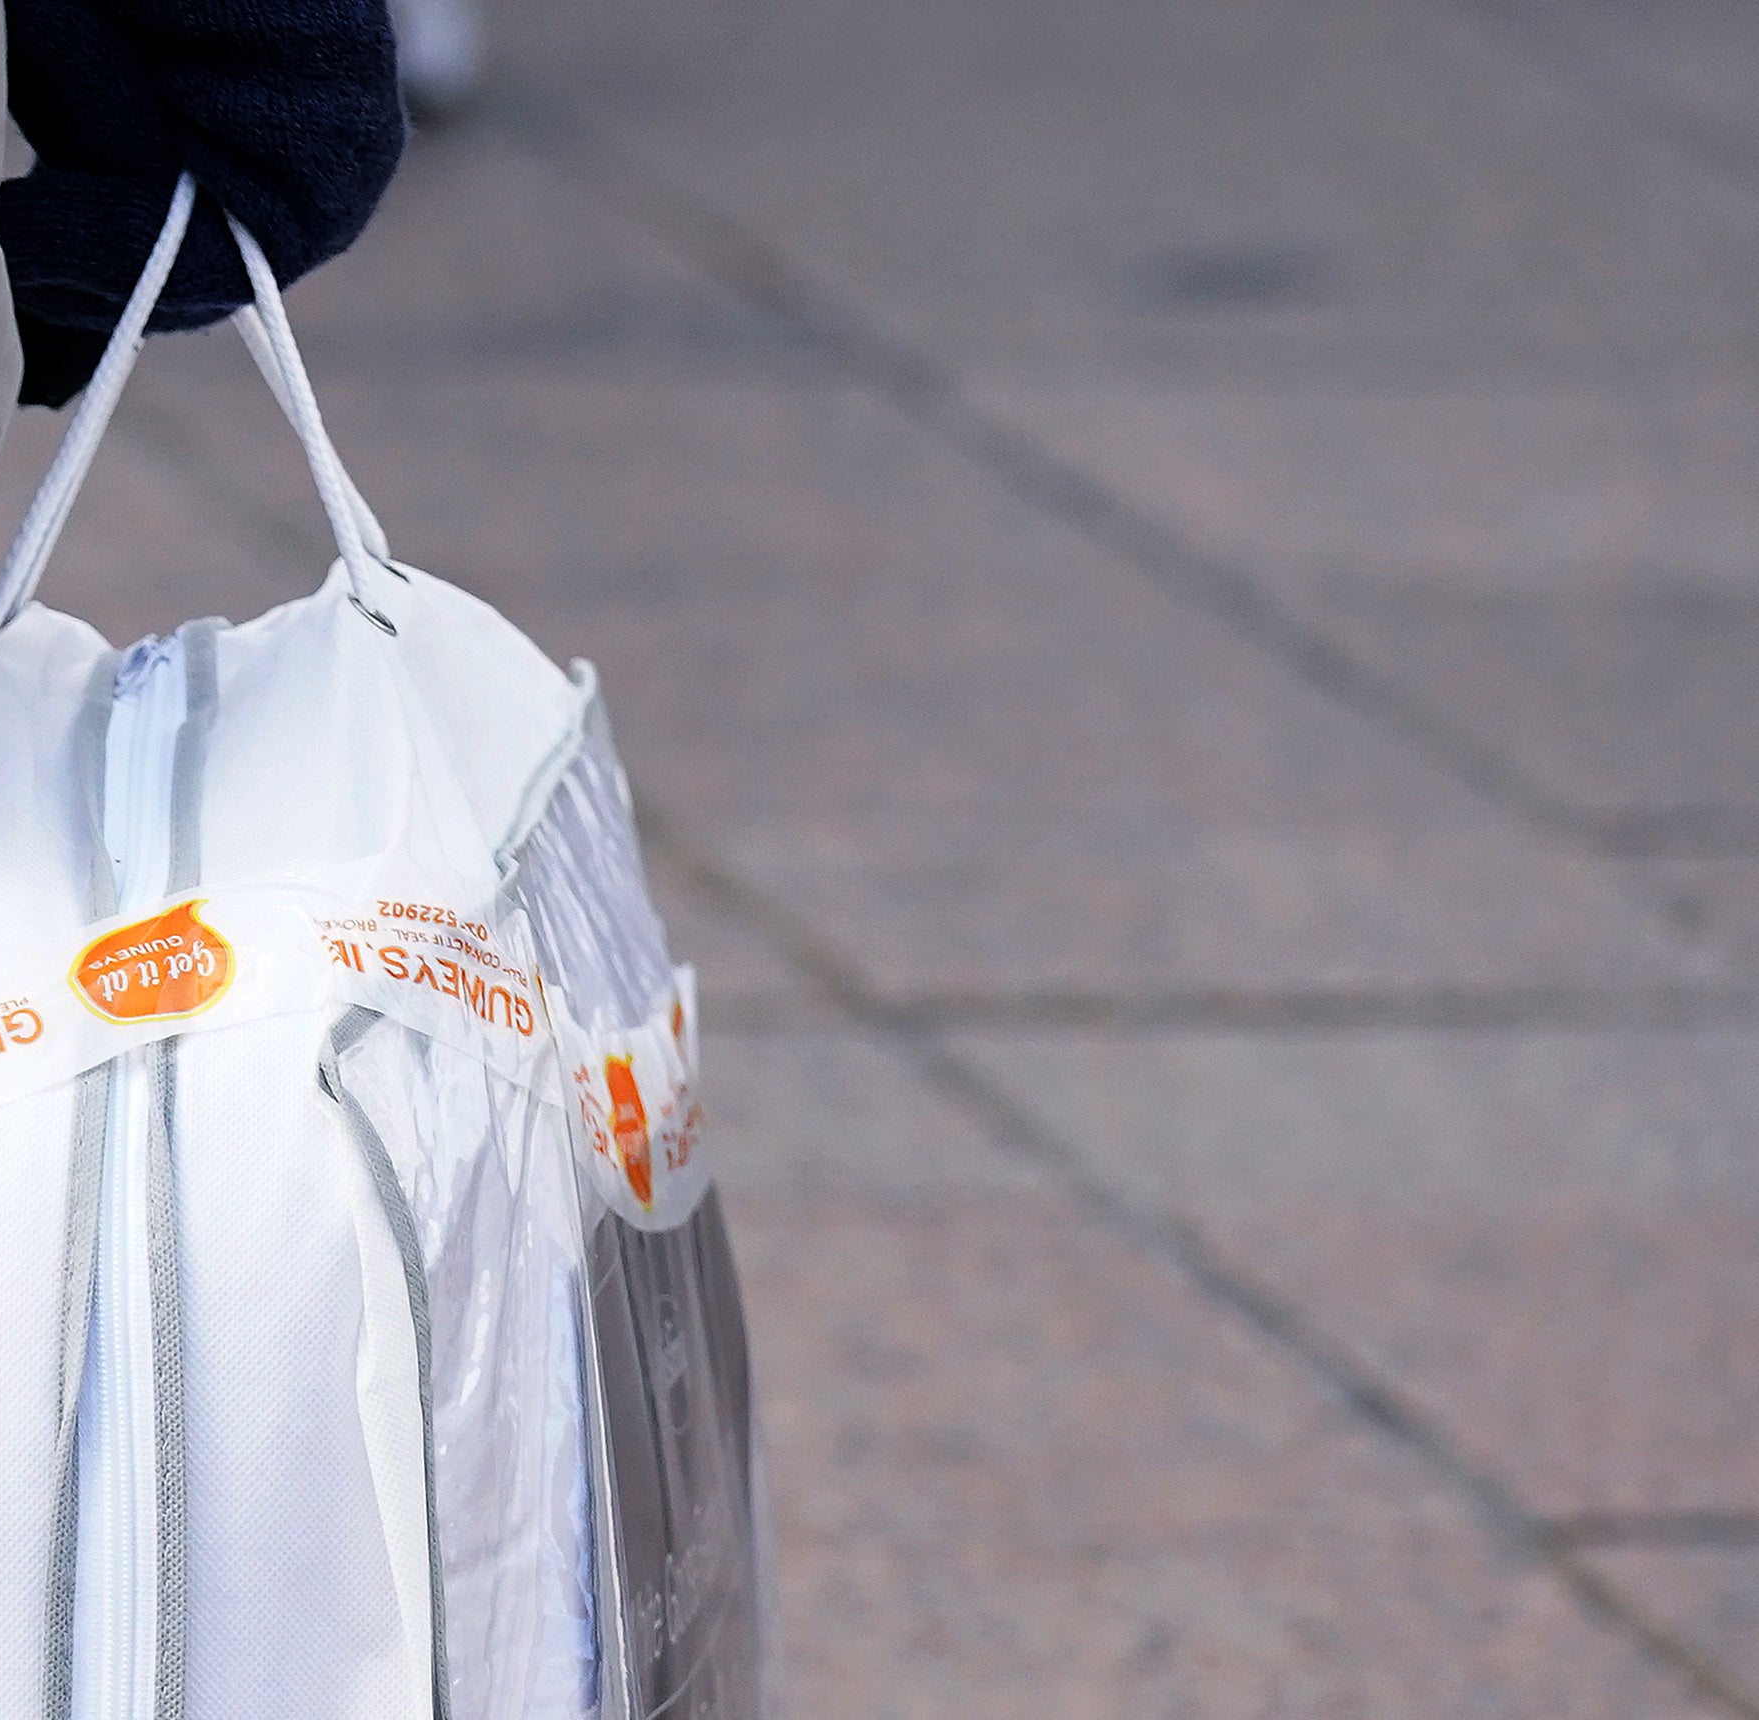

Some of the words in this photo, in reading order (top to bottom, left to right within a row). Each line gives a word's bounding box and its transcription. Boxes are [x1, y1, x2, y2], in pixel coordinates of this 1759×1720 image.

[392, 928, 429, 943] SEAL
[88, 935, 185, 970] GUINEYS
[163, 940, 216, 980] Get
[97, 969, 129, 1002] at
[135, 960, 160, 988] it
